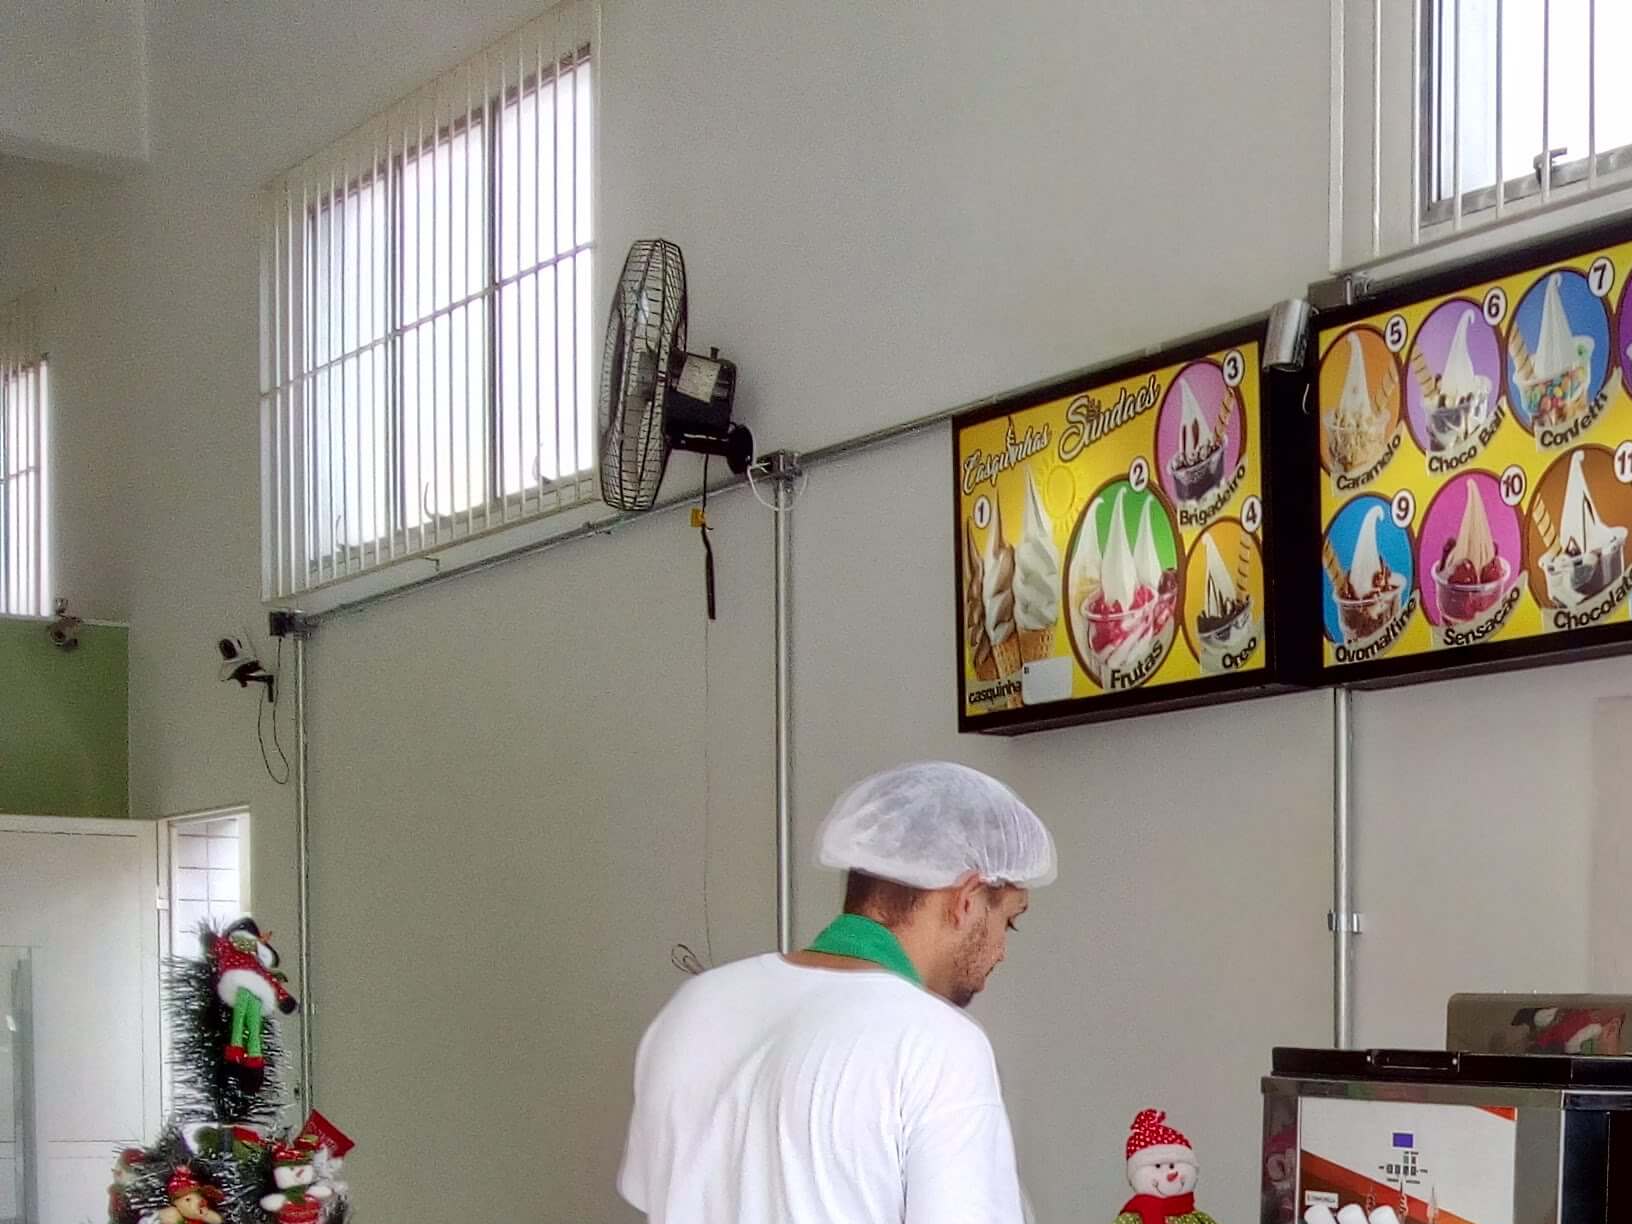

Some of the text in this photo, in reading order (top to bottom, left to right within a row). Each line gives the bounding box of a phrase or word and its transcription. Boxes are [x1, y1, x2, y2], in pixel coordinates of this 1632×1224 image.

[1594, 264, 1606, 289] 7
[1488, 294, 1500, 319] 6
[1390, 322, 1402, 346] 5
[1227, 357, 1239, 379] 3
[1058, 375, 1160, 462] Sundaes
[1540, 390, 1607, 447] Confetti
[1337, 433, 1401, 490] Caramelo
[1428, 446, 1477, 473] Choco
[1132, 464, 1145, 486] 2
[1504, 473, 1524, 498] 10
[1180, 464, 1246, 527] Brigadeiro
[1397, 494, 1410, 519] 9
[1246, 501, 1258, 524] 4
[1336, 598, 1417, 663] Ovomaltine
[1110, 638, 1163, 688] Frutas
[1222, 637, 1257, 669] Oreo
